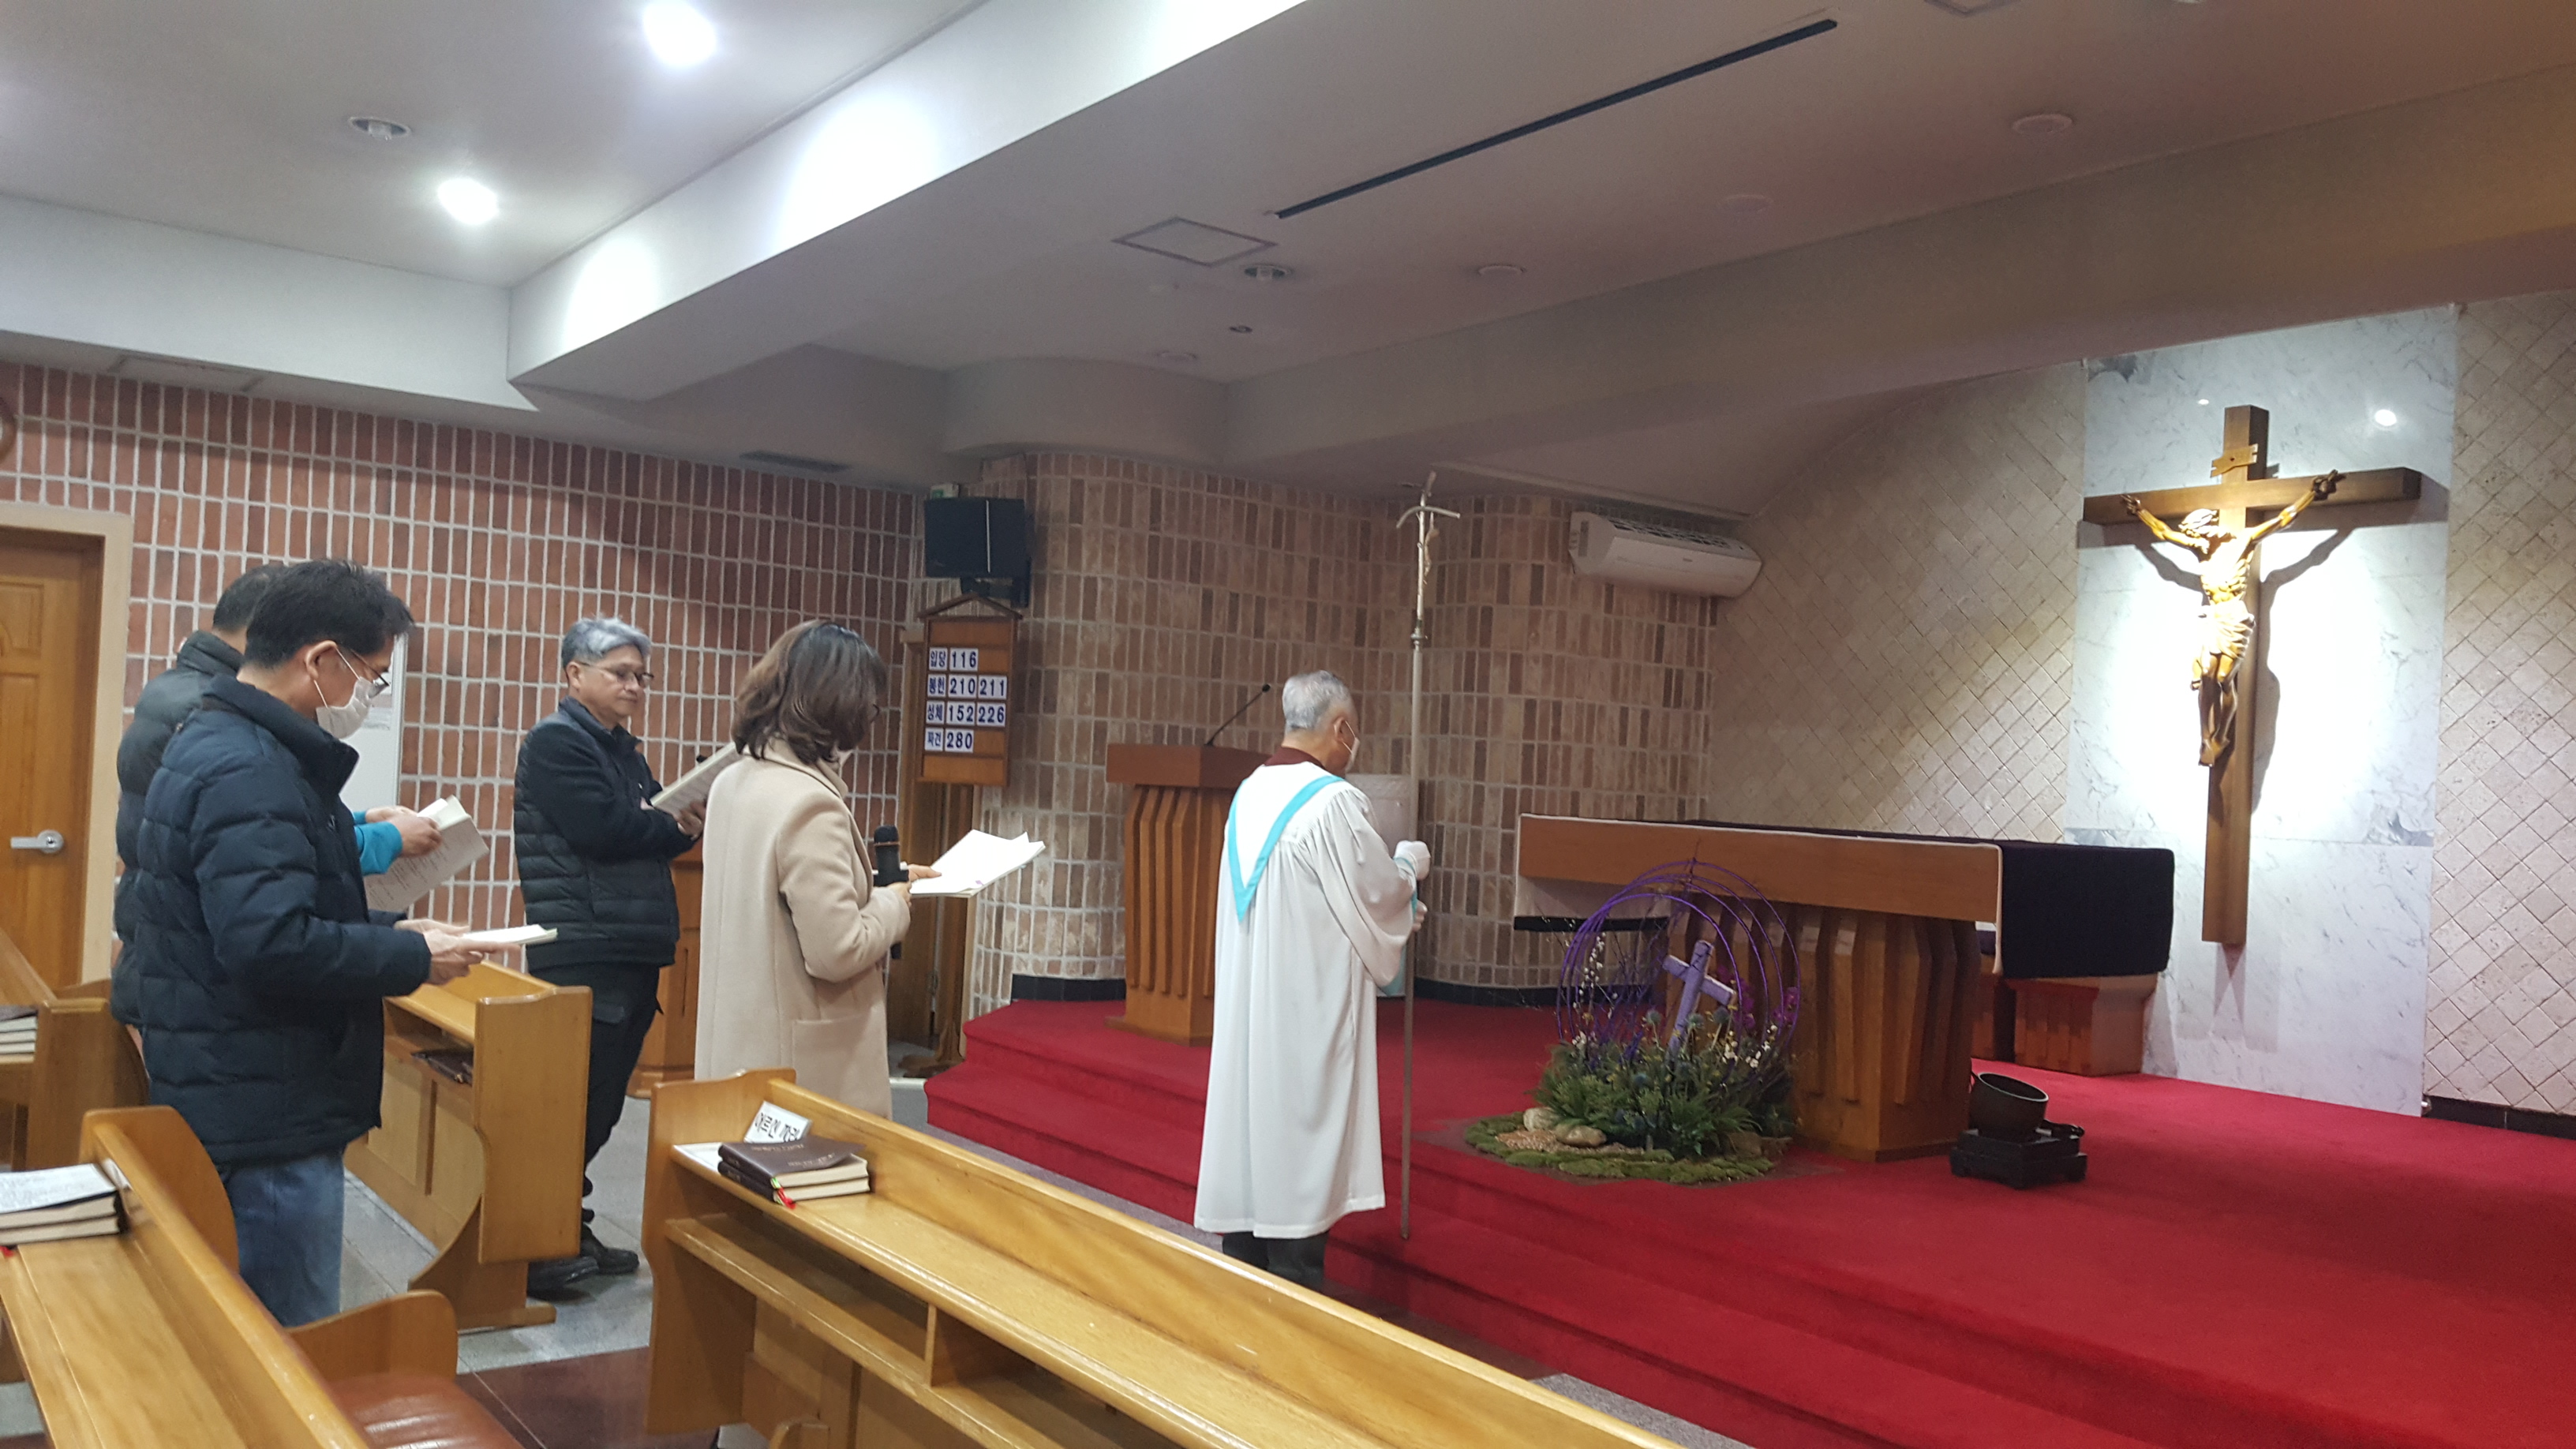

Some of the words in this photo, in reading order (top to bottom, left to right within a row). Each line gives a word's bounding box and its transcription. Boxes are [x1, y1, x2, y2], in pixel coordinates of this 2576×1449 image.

[930, 650, 946, 668] 입당
[952, 650, 977, 668] 116
[929, 676, 945, 695] 봉헌
[949, 678, 976, 695] 210
[979, 679, 1005, 696] 211
[927, 704, 943, 721] 성체
[949, 705, 974, 723] 152
[978, 706, 1005, 723] 226
[927, 731, 942, 747] 파견
[946, 732, 973, 749] 280
